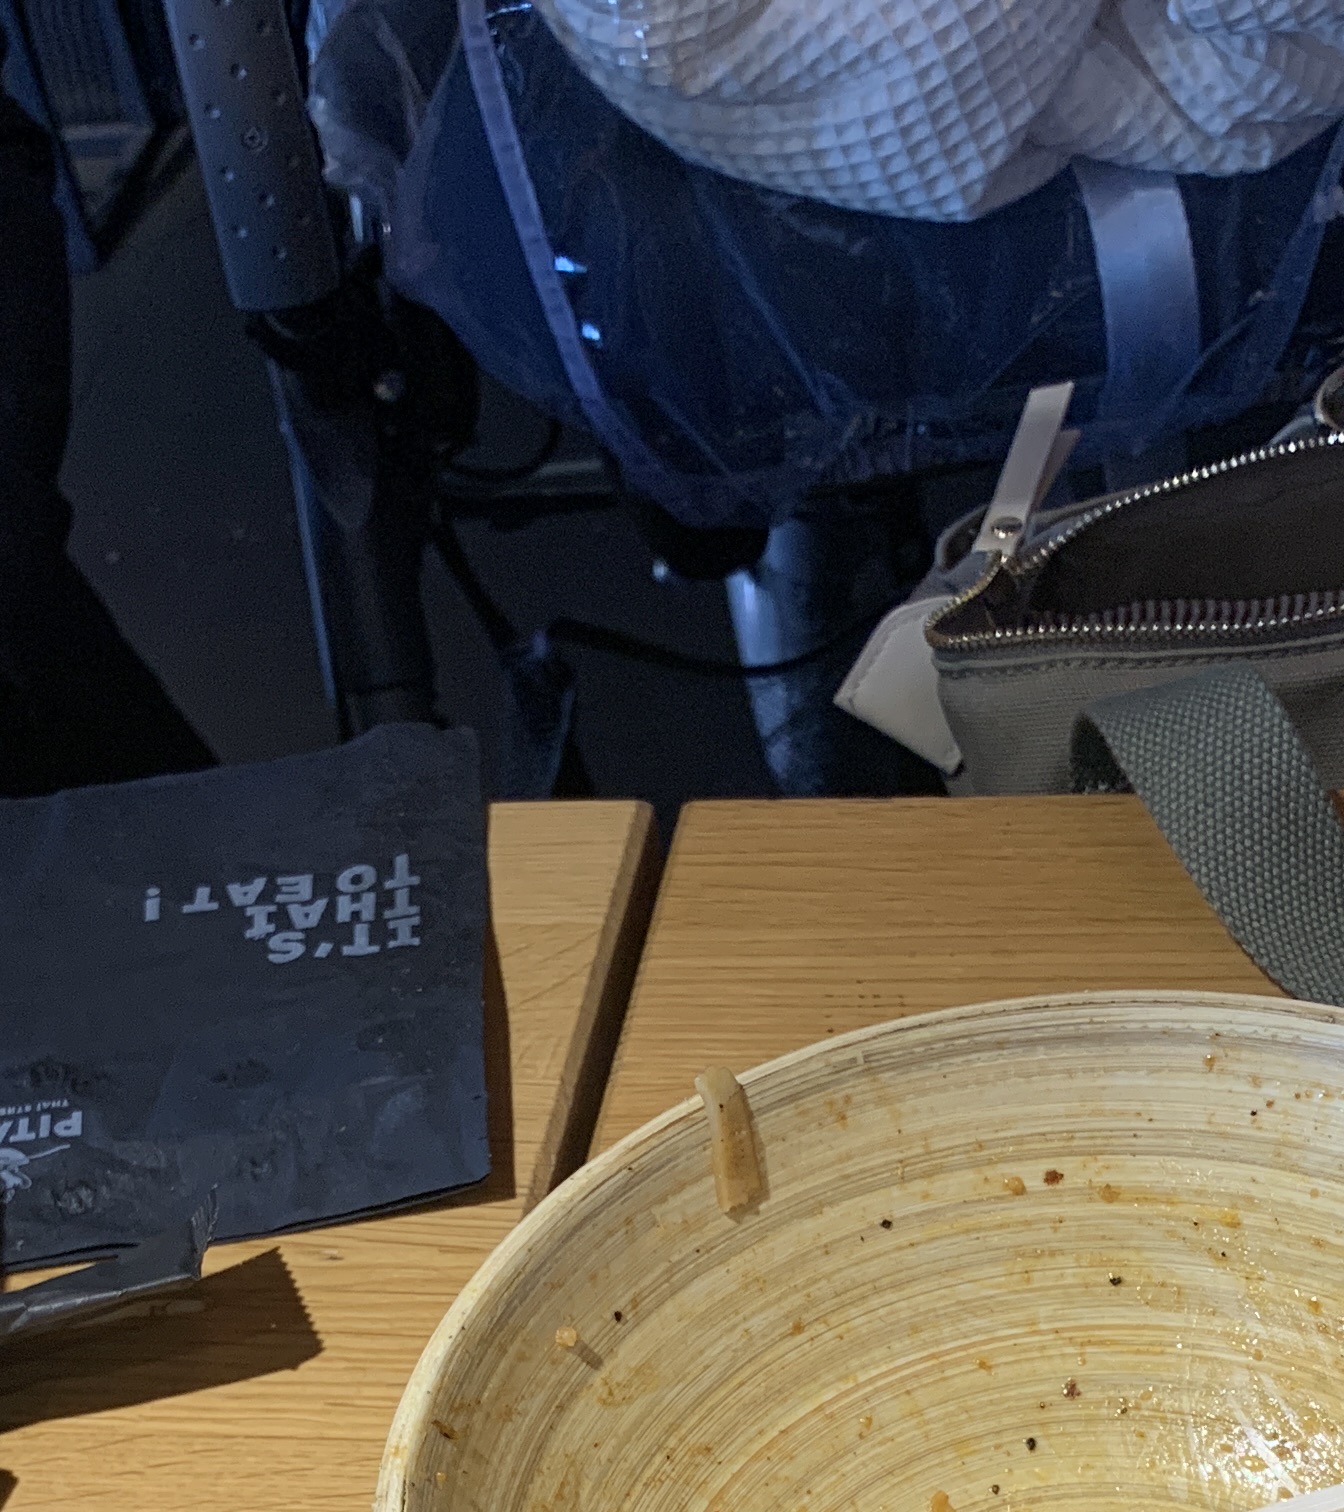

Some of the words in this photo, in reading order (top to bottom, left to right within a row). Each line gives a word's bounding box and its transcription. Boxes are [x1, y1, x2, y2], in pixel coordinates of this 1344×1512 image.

[336, 854, 420, 893] TO
[182, 874, 313, 914] EAT
[268, 916, 421, 964] IT'S
